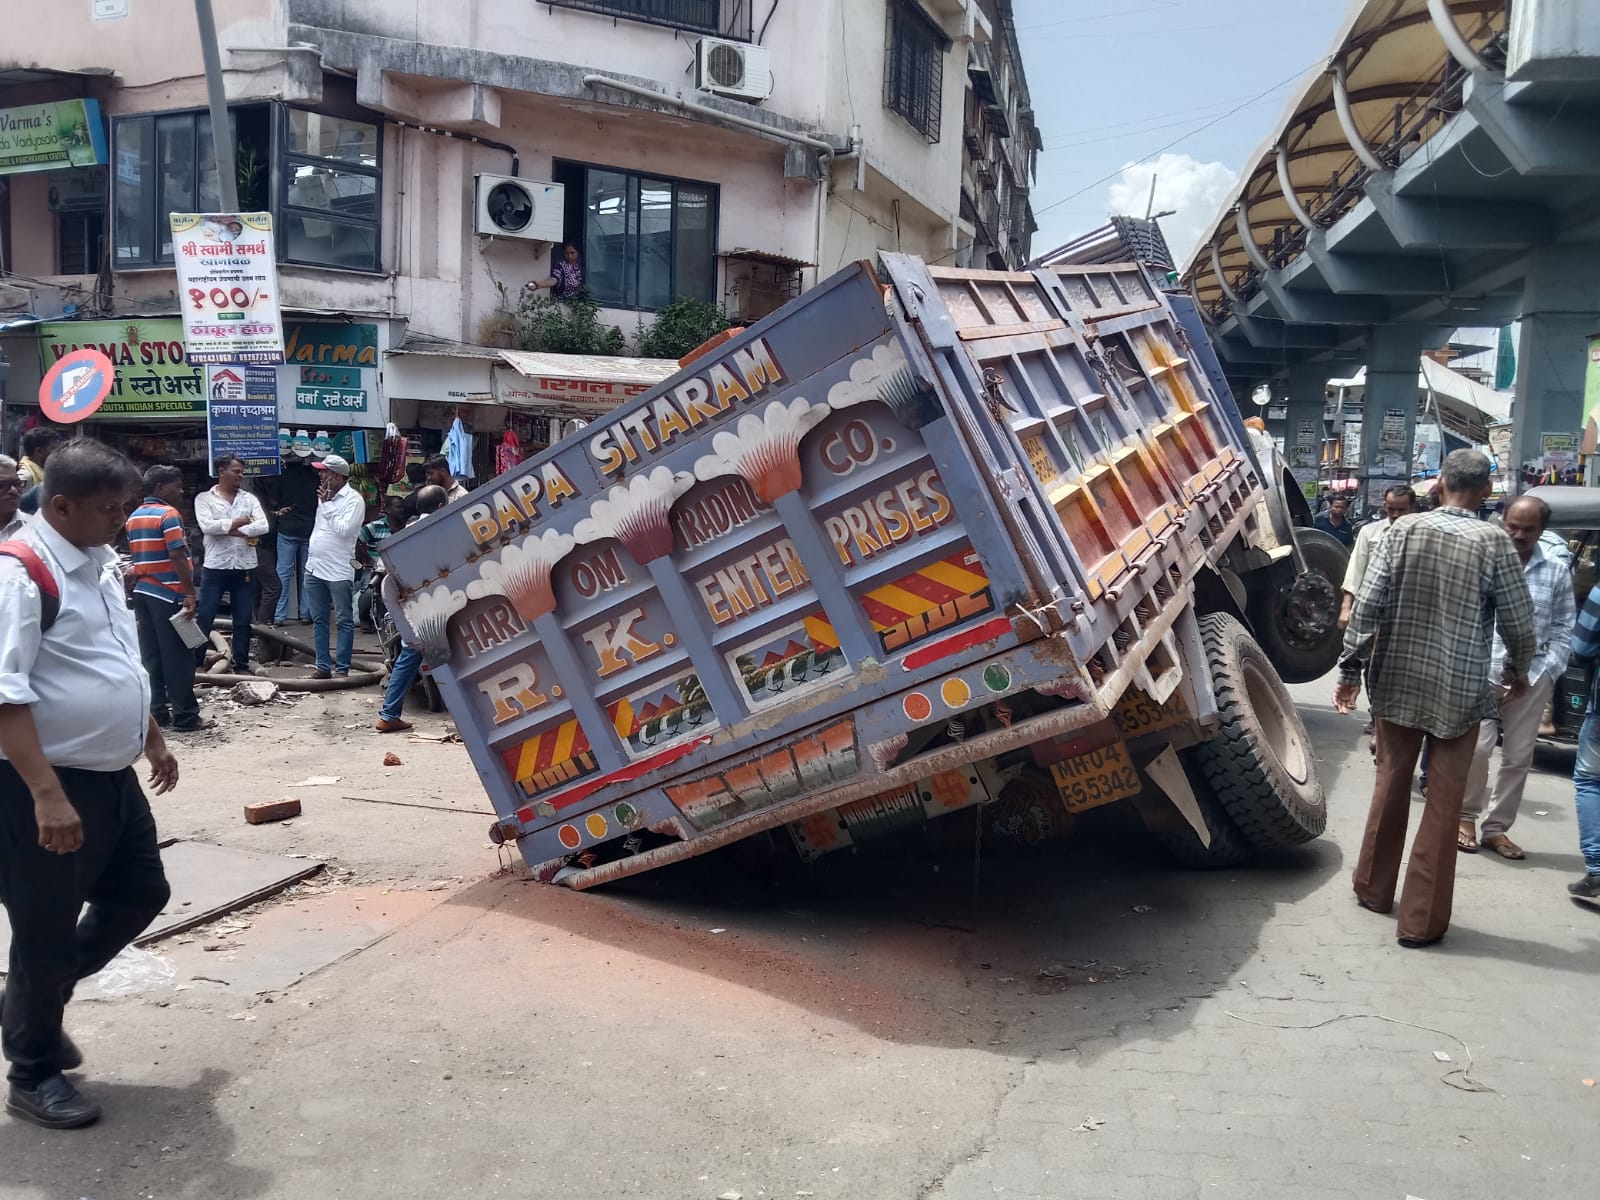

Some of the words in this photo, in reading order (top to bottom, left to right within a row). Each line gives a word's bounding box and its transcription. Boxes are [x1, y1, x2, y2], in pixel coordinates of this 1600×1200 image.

[0, 109, 52, 132] Varma's
[182, 240, 198, 256] श्री
[200, 240, 233, 256] स्वामी
[236, 239, 266, 255] समर्थ
[140, 341, 187, 366] STO
[129, 368, 202, 396] स्टोअर्स
[59, 391, 71, 403] NO
[126, 401, 154, 411] INDIAN
[156, 401, 192, 410] SPECIALS
[297, 390, 319, 405] वर्मा
[210, 405, 238, 417] कृष्णा
[460, 459, 579, 546] BAPA
[590, 336, 786, 476] SITARAM
[458, 603, 529, 659] HARI
[570, 545, 628, 600] OM
[820, 418, 897, 477] CO.
[479, 662, 564, 725] R.
[583, 607, 676, 678] K.
